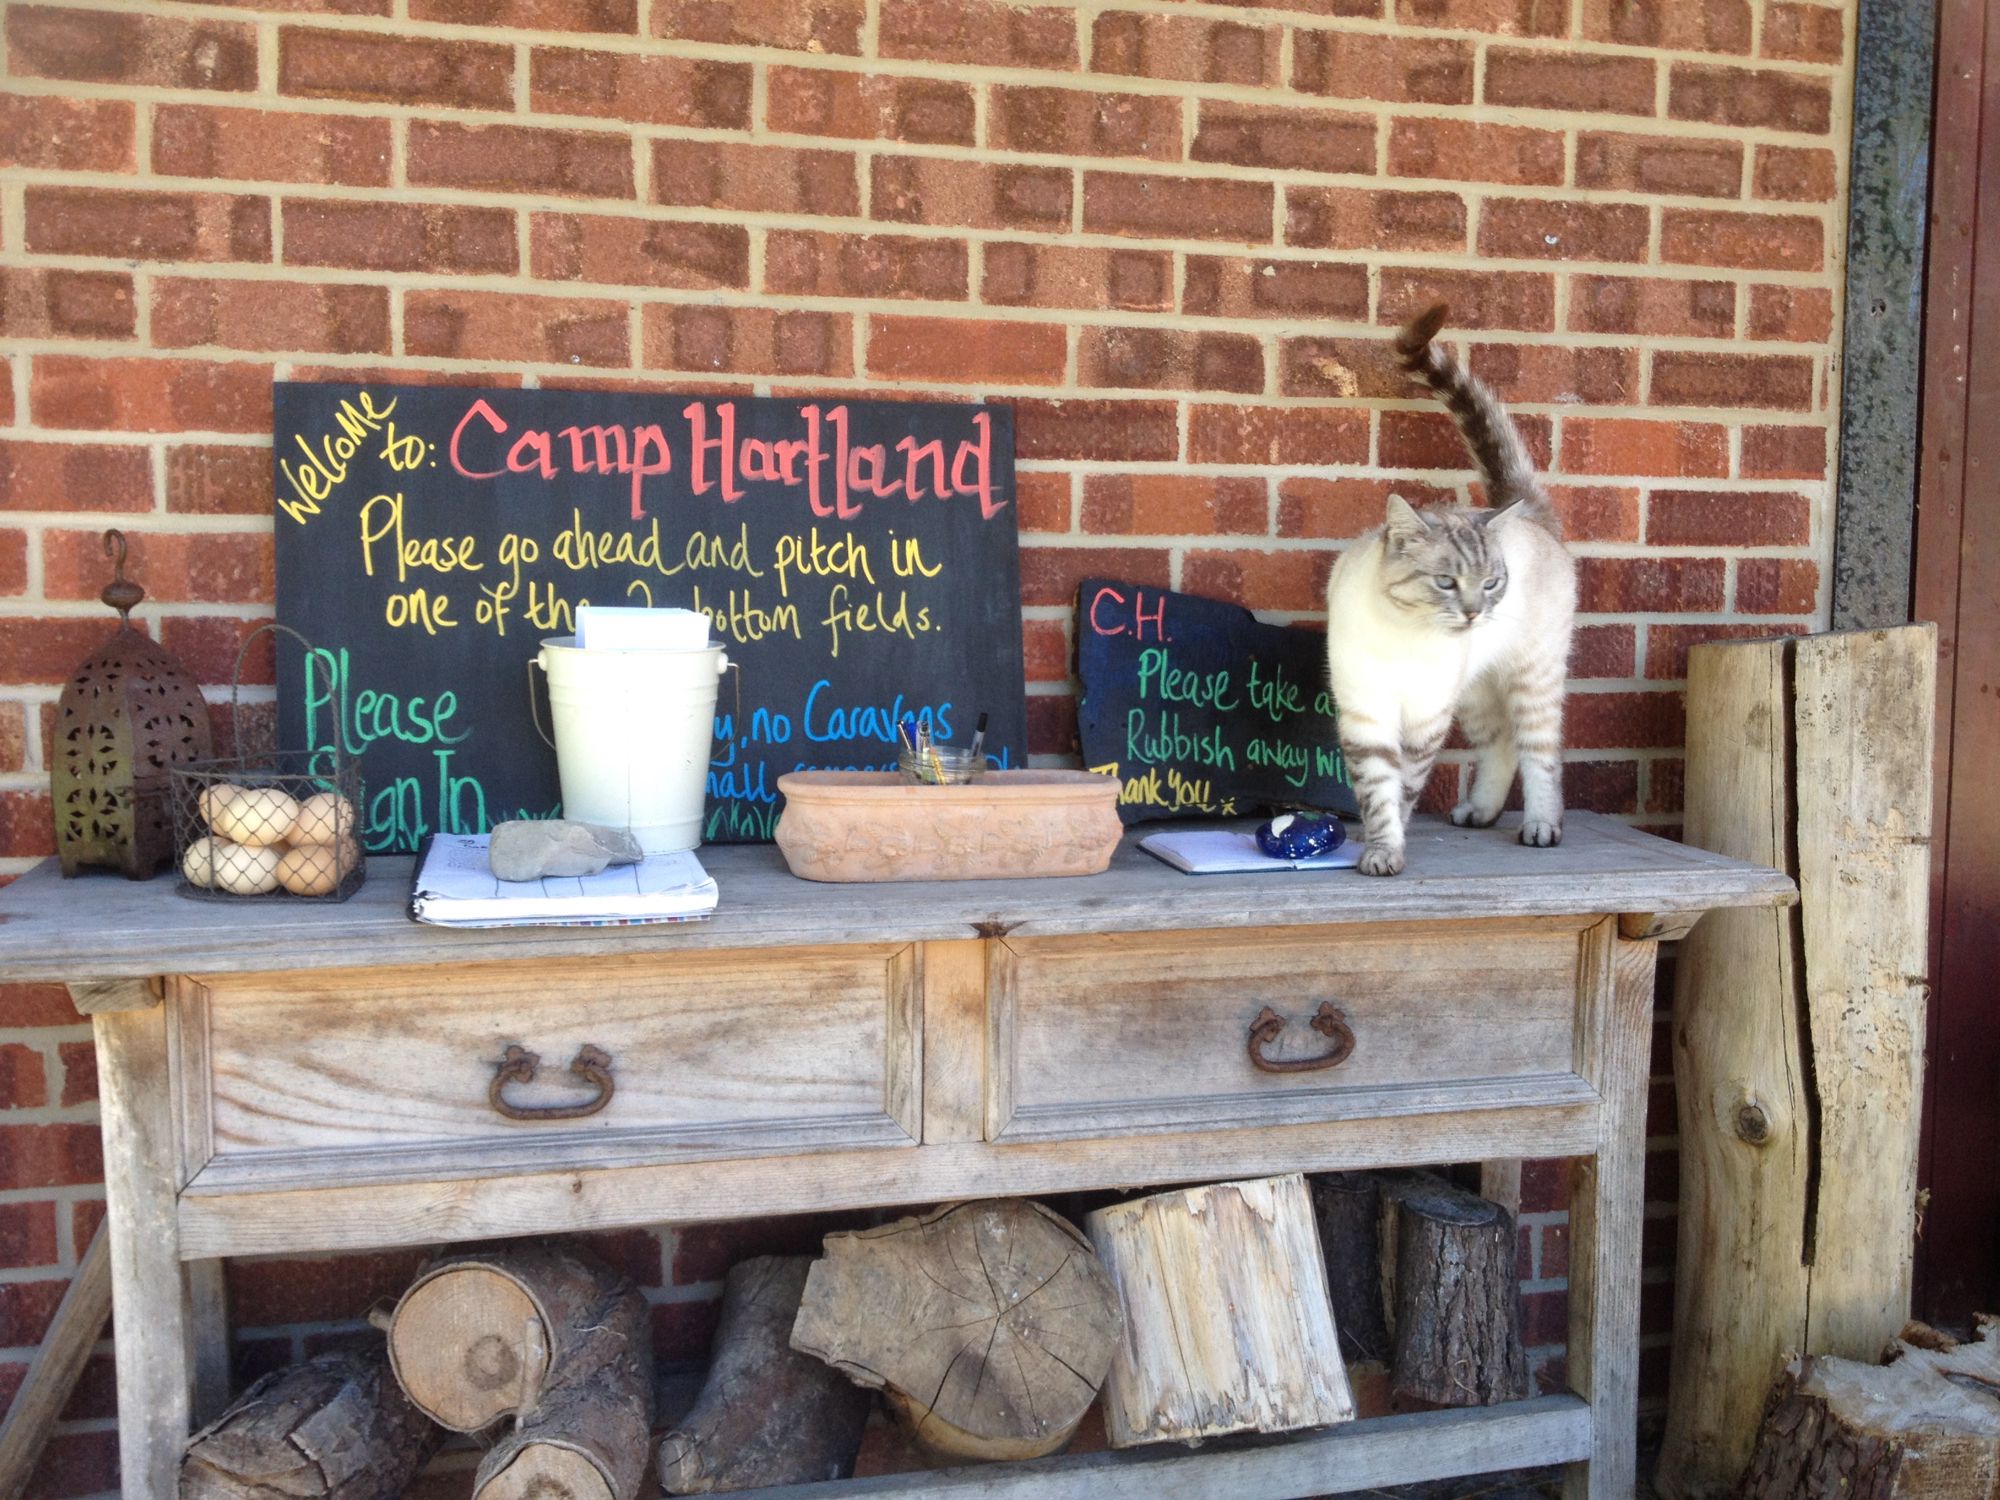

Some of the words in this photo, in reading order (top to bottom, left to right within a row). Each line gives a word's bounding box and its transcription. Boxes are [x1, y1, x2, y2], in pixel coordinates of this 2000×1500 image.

[379, 422, 436, 472] to:
[450, 399, 672, 520] Camp
[683, 401, 1008, 520] Hartland
[360, 493, 484, 582] Please
[480, 533, 539, 600] go
[553, 507, 685, 578] ahead
[686, 522, 763, 578] and
[774, 527, 875, 597] pitch
[889, 530, 942, 577] in
[386, 588, 458, 635] one
[476, 582, 511, 636] of
[821, 584, 942, 658] fields.
[1090, 587, 1173, 642] C.H.
[304, 647, 475, 756] Please
[1137, 648, 1240, 711] Please
[1247, 661, 1306, 722] take
[752, 707, 791, 743] no
[1127, 708, 1235, 772] Rubbish
[1246, 738, 1308, 788] away
